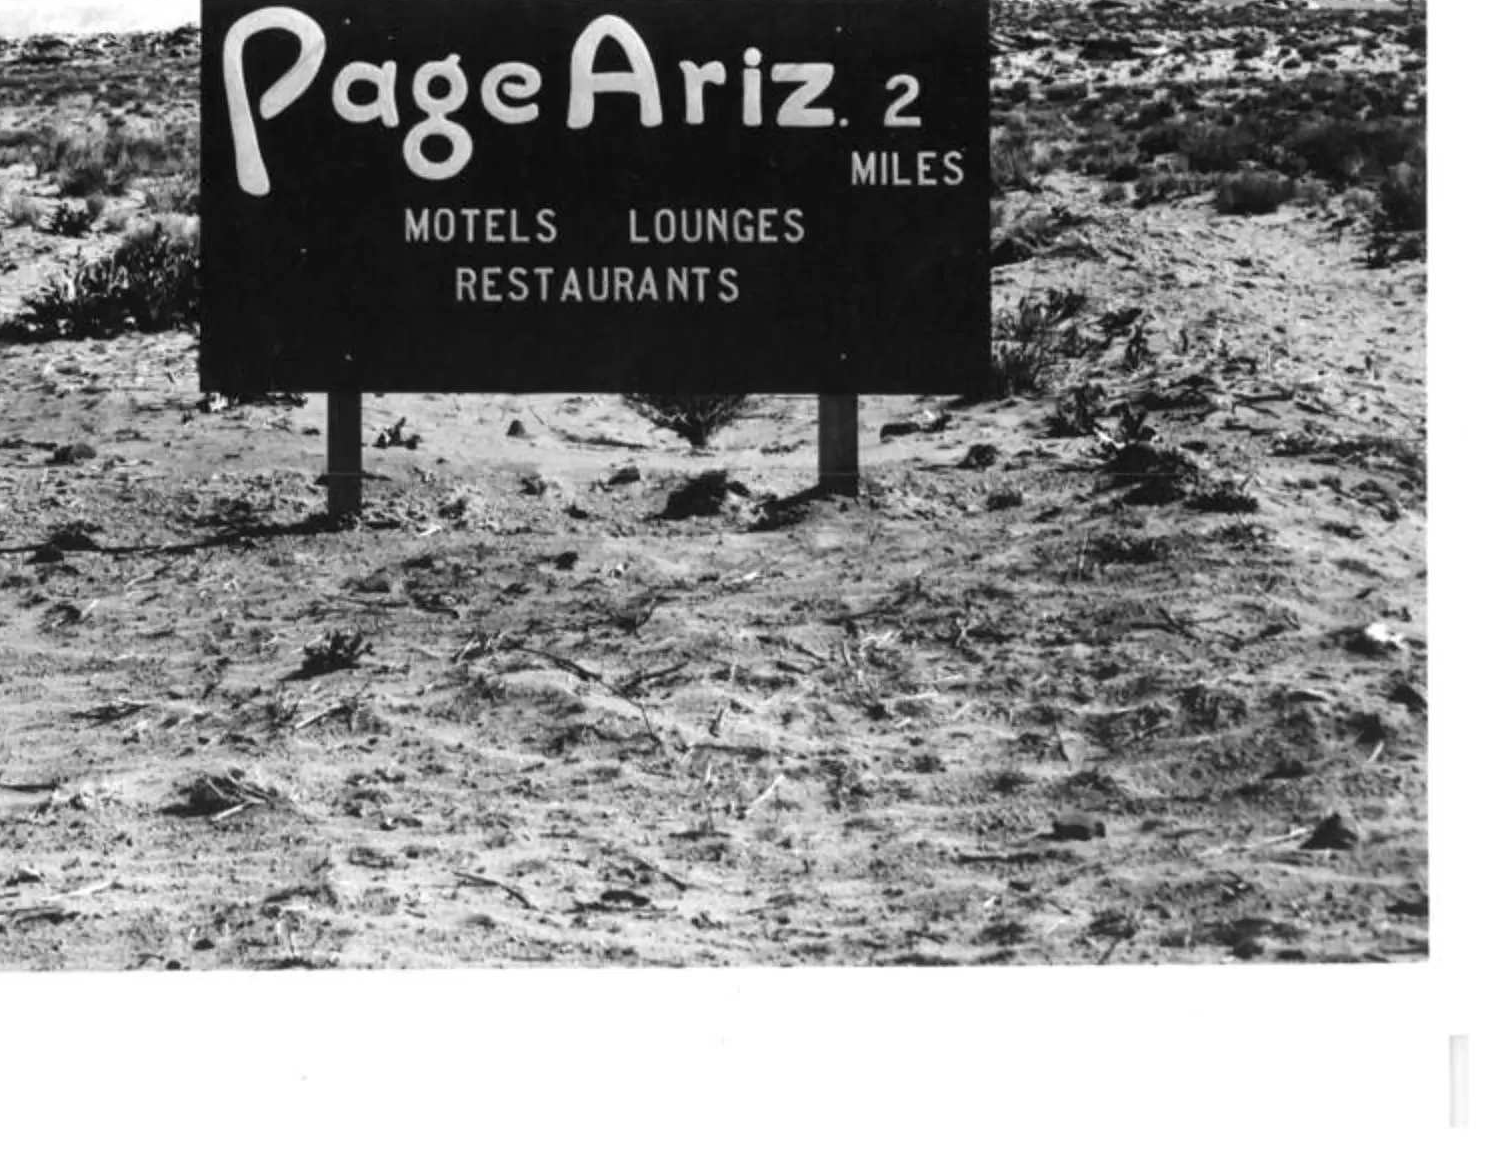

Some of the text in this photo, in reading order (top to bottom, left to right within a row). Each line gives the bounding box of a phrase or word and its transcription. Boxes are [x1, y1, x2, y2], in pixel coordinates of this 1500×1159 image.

[222, 6, 543, 197] Page
[883, 74, 922, 127] 2
[850, 150, 965, 187] MILES
[404, 207, 806, 243] MOTELS LOUNGES
[455, 266, 740, 302] RESTAURANTS
